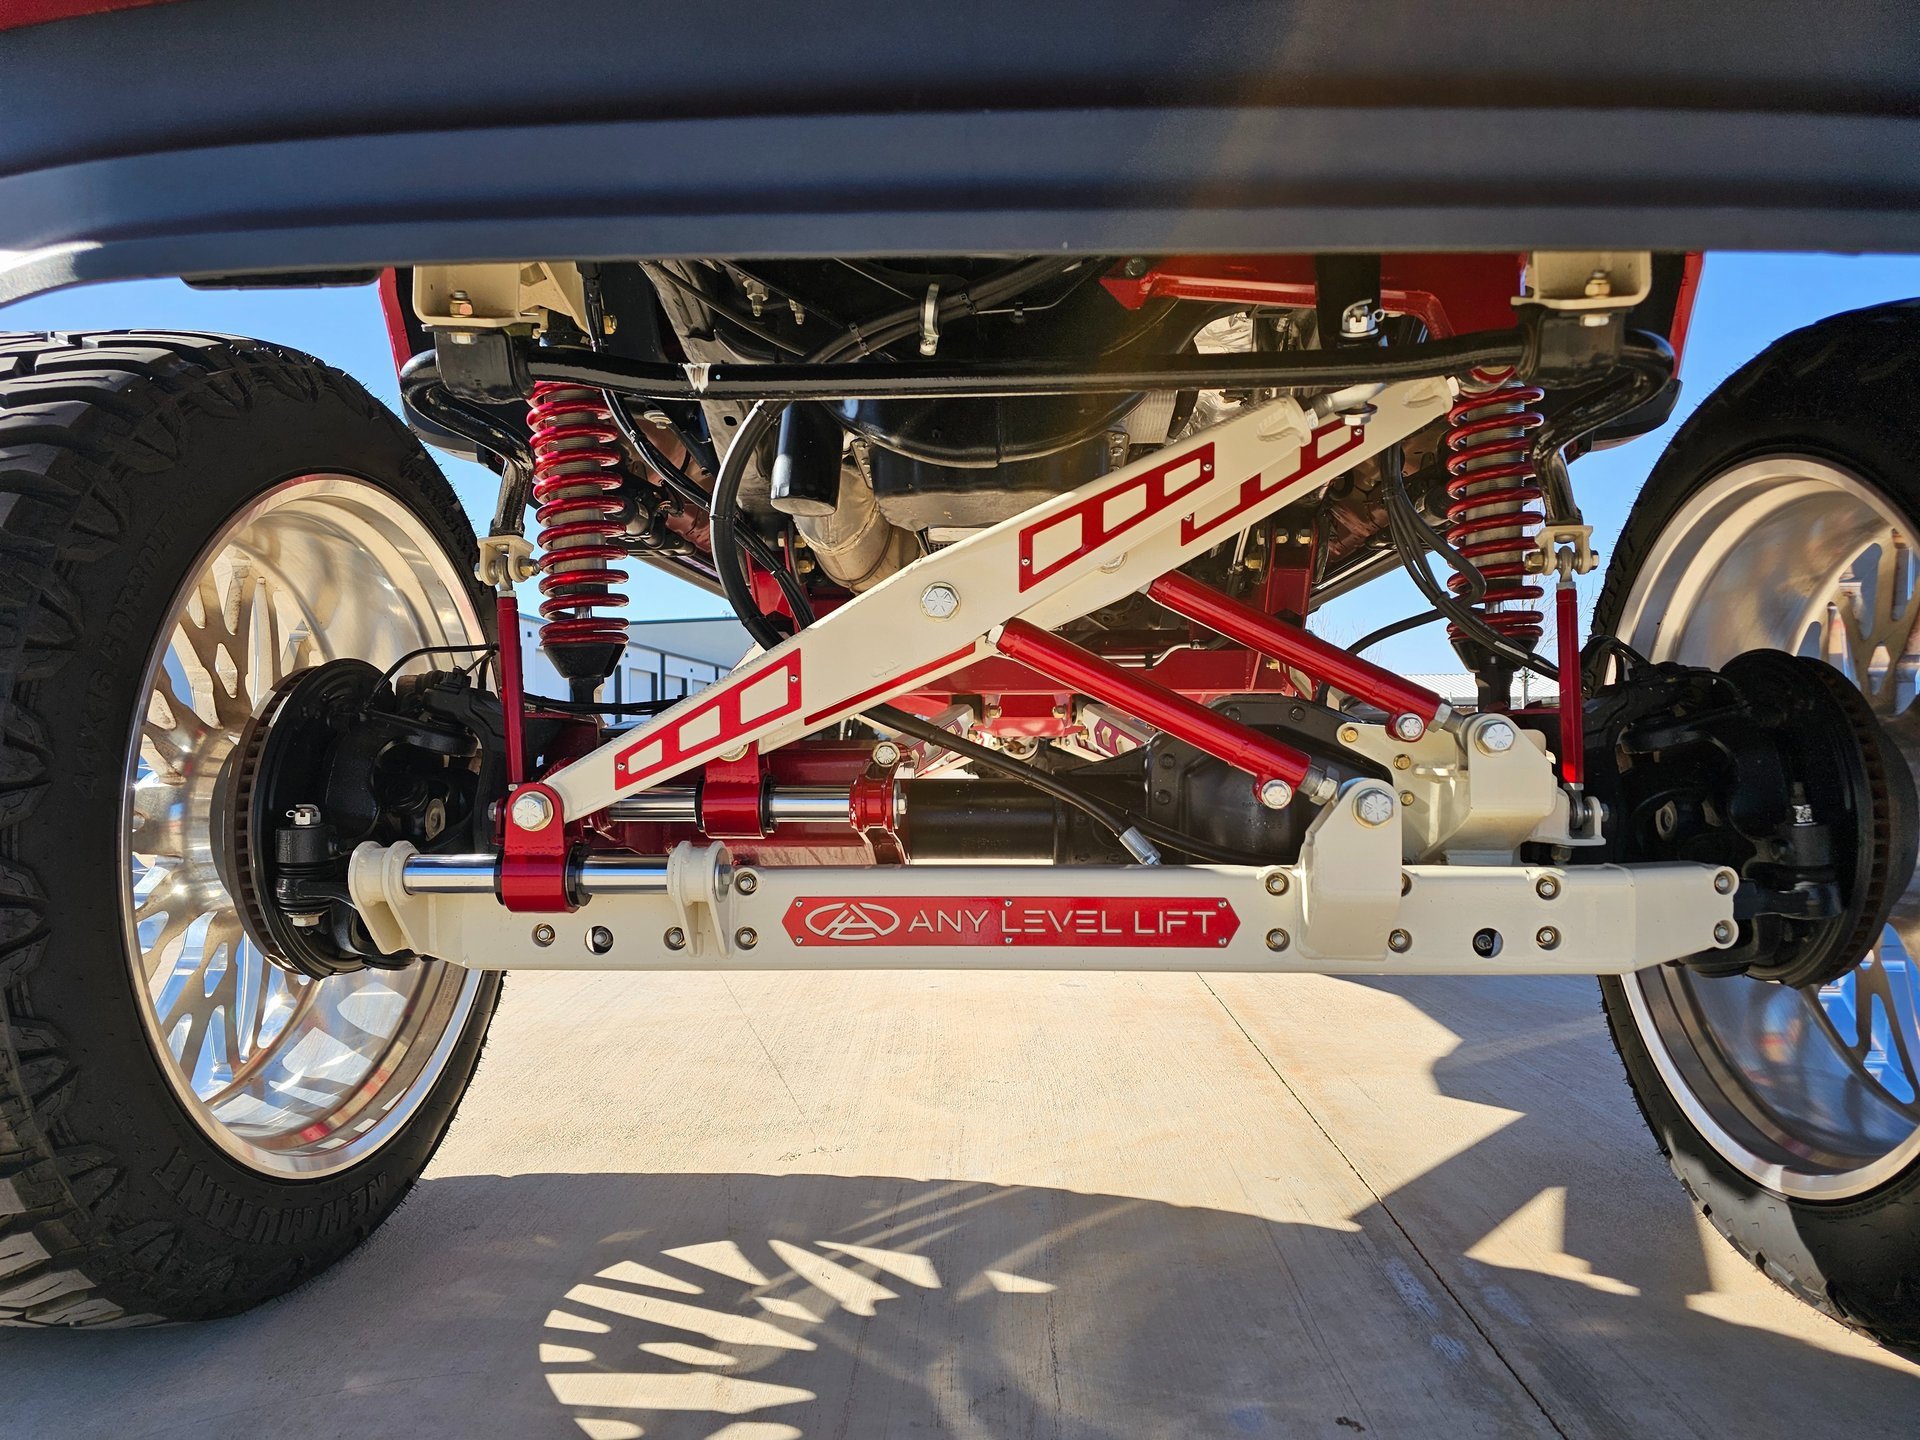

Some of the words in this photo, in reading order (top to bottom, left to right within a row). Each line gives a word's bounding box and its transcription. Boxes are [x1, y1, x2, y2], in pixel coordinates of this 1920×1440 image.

[907, 909, 989, 933] ANY
[1001, 909, 1122, 934] LEVEL
[1134, 910, 1217, 934] LIFT
[151, 1146, 321, 1245] MUTANT
[318, 1170, 388, 1238] NEW
